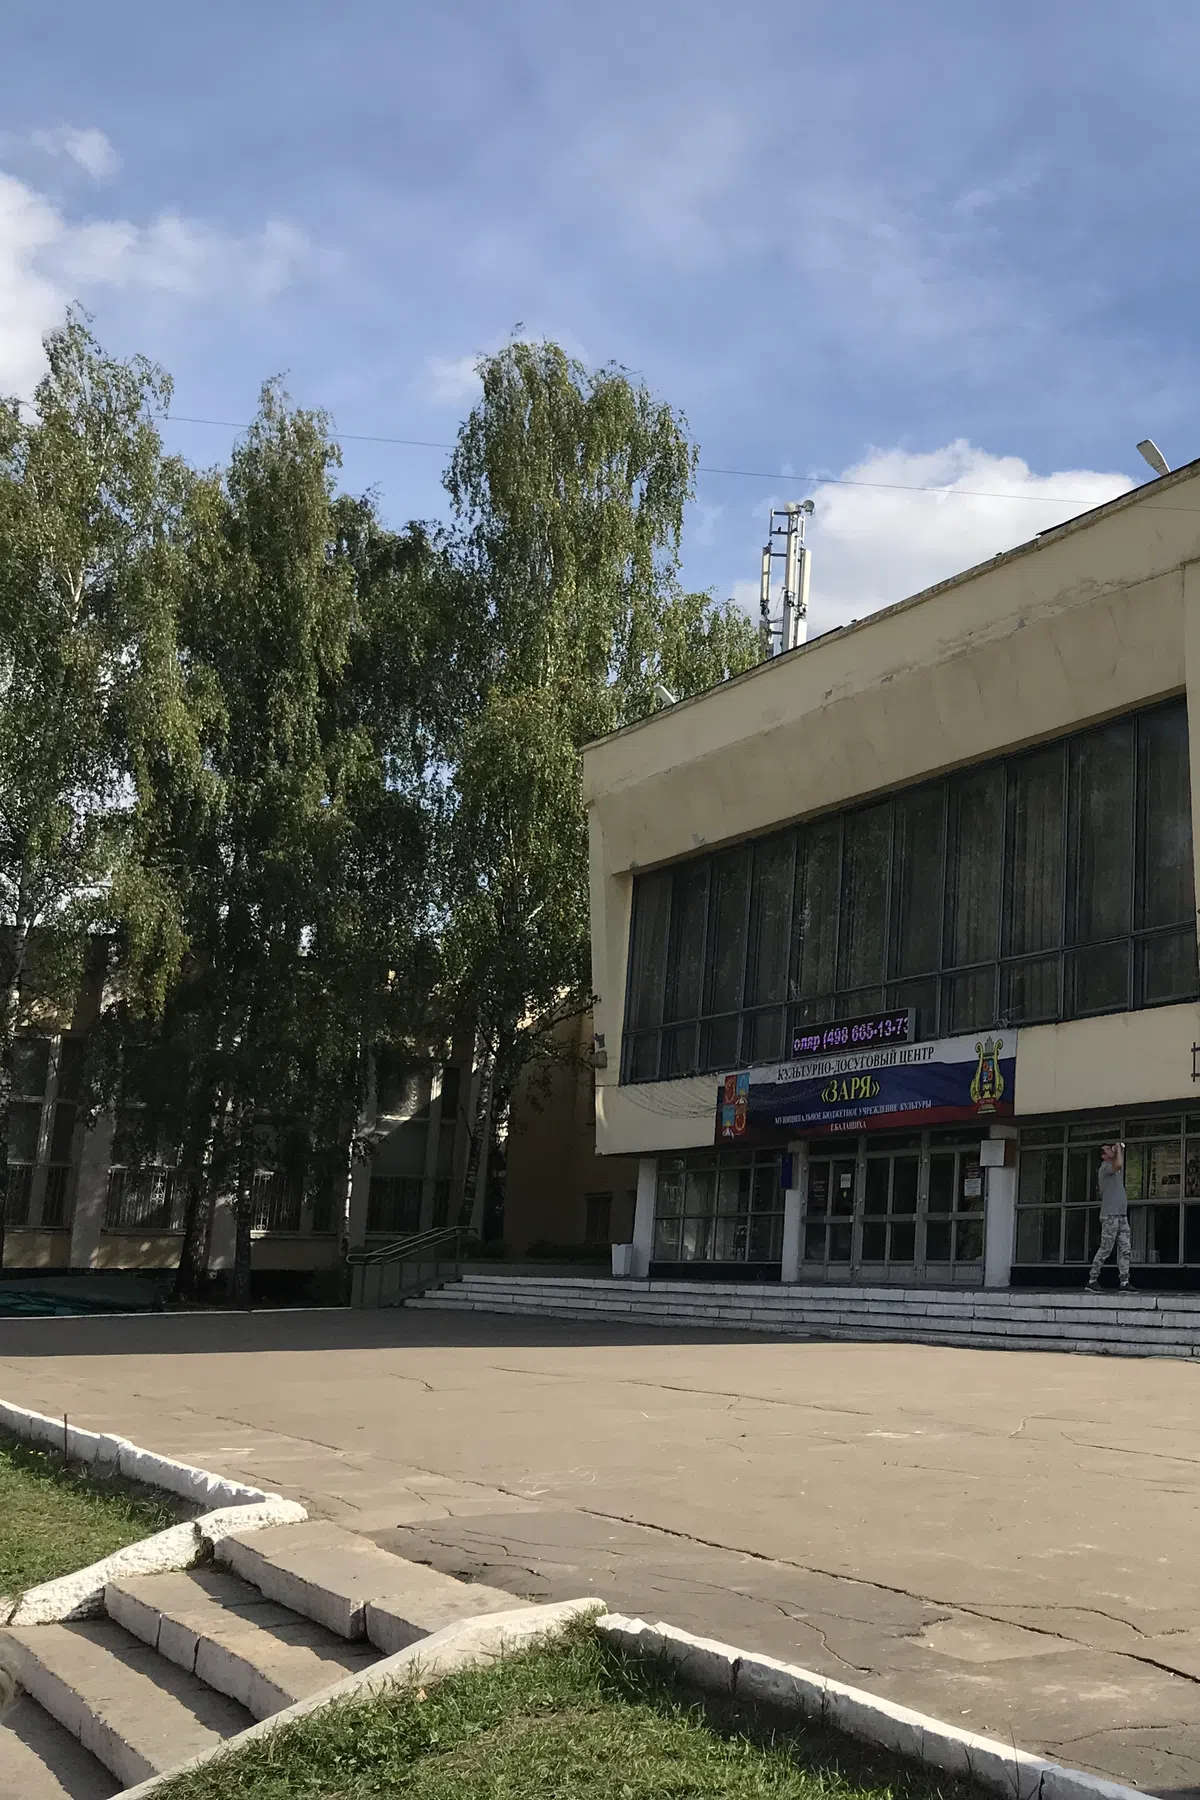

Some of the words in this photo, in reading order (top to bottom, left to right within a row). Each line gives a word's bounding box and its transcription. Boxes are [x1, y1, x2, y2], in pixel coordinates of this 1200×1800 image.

[778, 1051, 896, 1080] КУЛЬТУРНО-ДОСУГОВЫЙ
[899, 1047, 934, 1063] ЦЕНТР
[821, 1075, 880, 1103] «ЗАРЯ»
[774, 1111, 822, 1124] МУНИЦИПАЛЬНОЕ
[822, 1107, 857, 1119] БЮДЖЕТНОЕ
[858, 1104, 897, 1116] УЧРЕЖДЕНИЕ
[899, 1100, 932, 1111] КУЛЬТУРЫ
